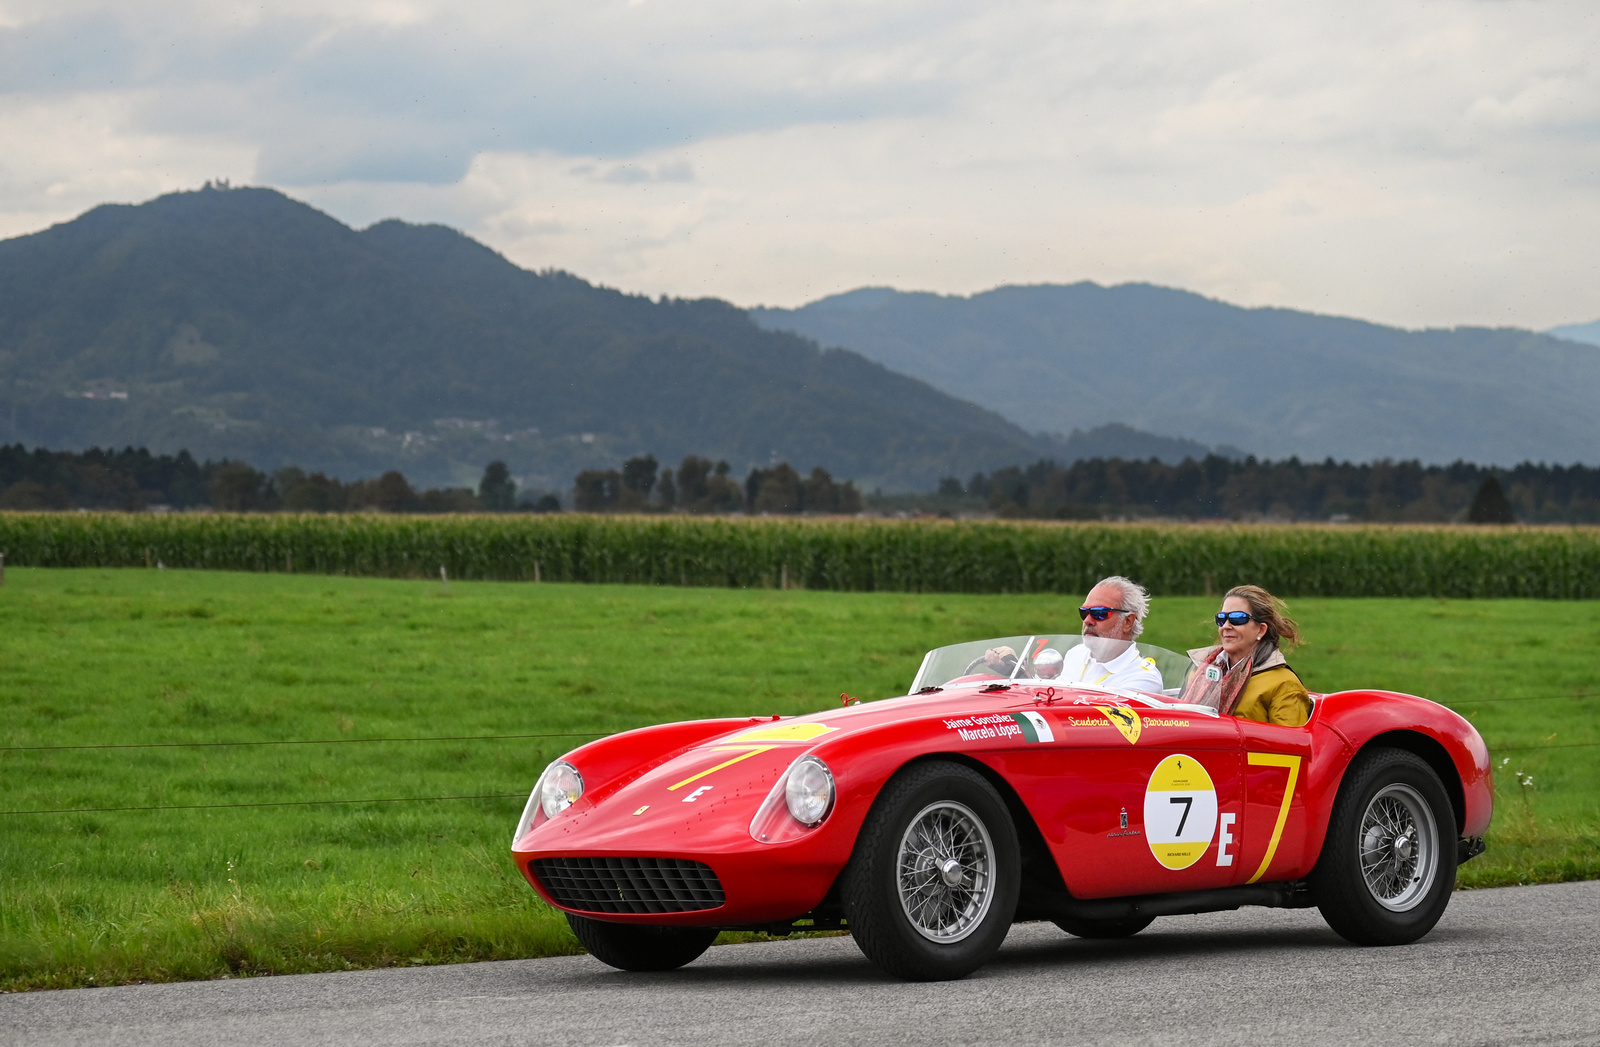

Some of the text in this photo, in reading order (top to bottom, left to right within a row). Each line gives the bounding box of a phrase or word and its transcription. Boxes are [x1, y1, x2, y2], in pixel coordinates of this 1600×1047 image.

[943, 713, 1015, 729] Jaime González
[958, 723, 1022, 741] Marcela López
[1068, 716, 1190, 728] Scuderia Parravano
[667, 744, 782, 792] 7
[681, 785, 714, 802] E
[1169, 797, 1193, 837] 7
[1244, 752, 1302, 885] 7
[1215, 812, 1236, 867] E
